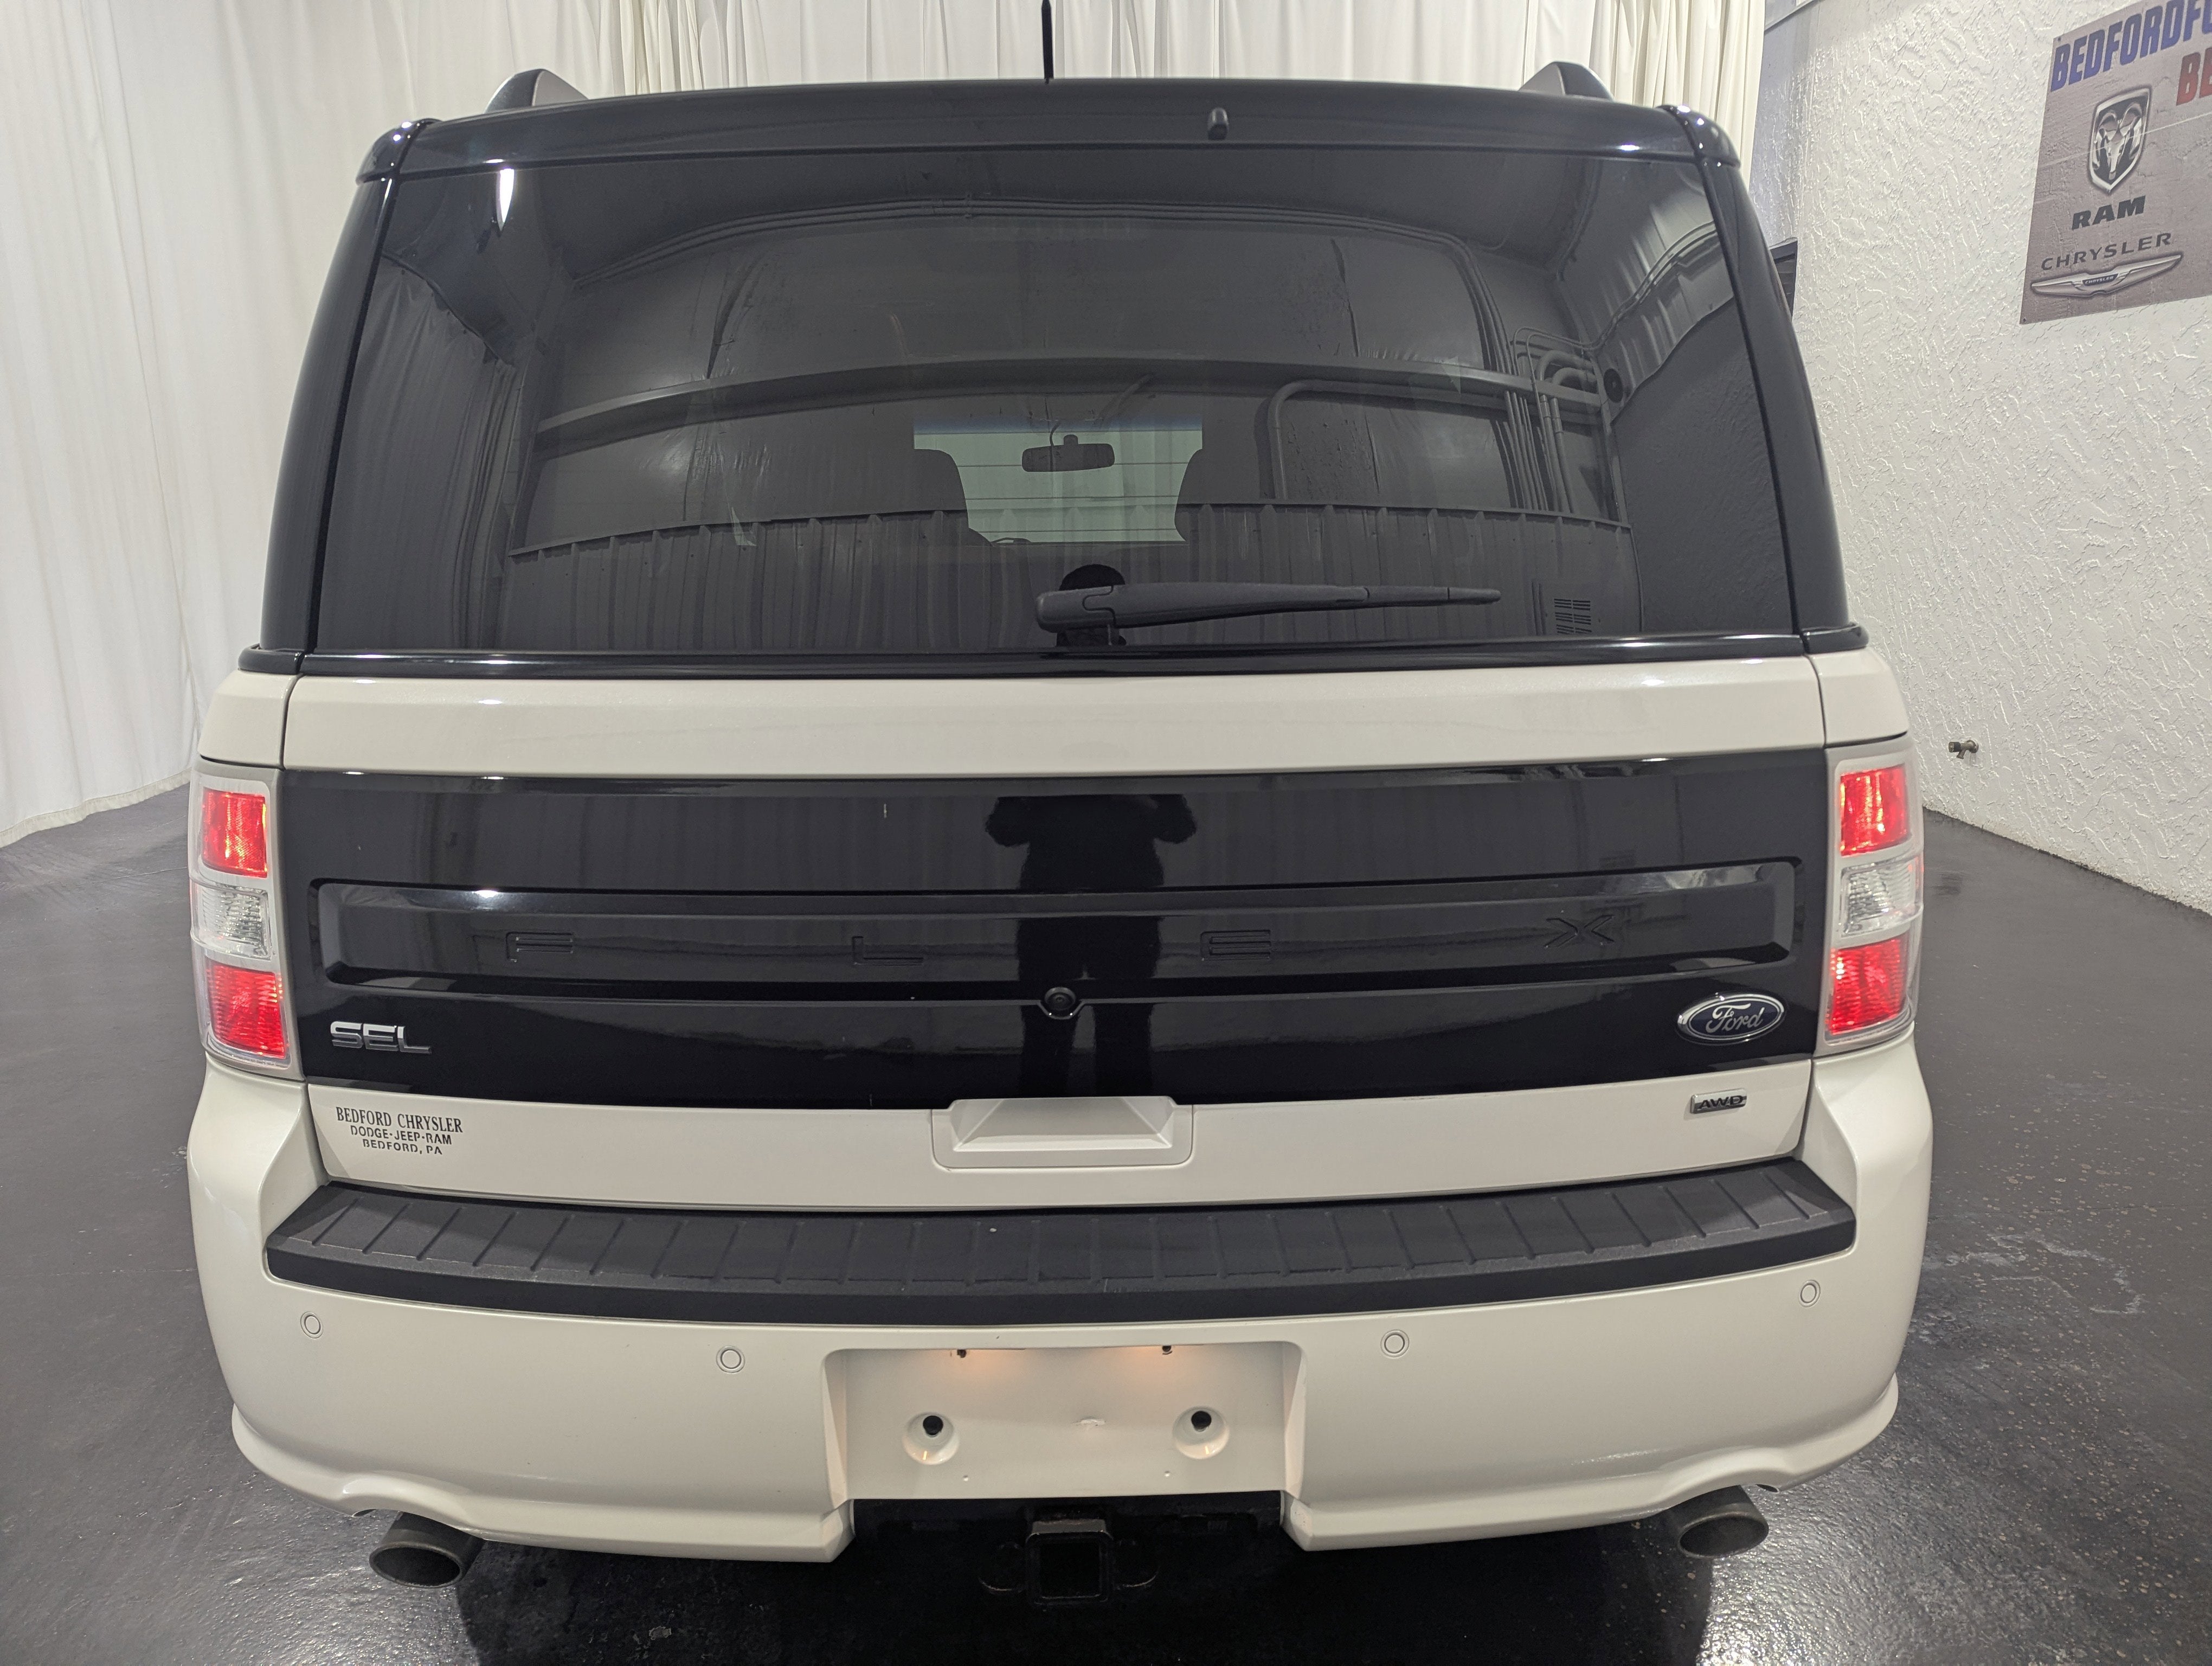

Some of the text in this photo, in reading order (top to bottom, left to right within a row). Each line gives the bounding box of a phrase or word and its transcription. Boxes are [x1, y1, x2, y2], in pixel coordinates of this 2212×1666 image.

[2071, 195, 2146, 230] RAM
[2041, 232, 2171, 270] CHRYSLER
[2085, 276, 2114, 284] CHRYSLER
[1706, 1003, 1765, 1033] Ford
[330, 1021, 432, 1054] SEL
[1697, 1094, 1744, 1110] AWD
[336, 1106, 463, 1133] BEDFORD CHRYSLER
[363, 1139, 442, 1155] BEDFORD, PA
